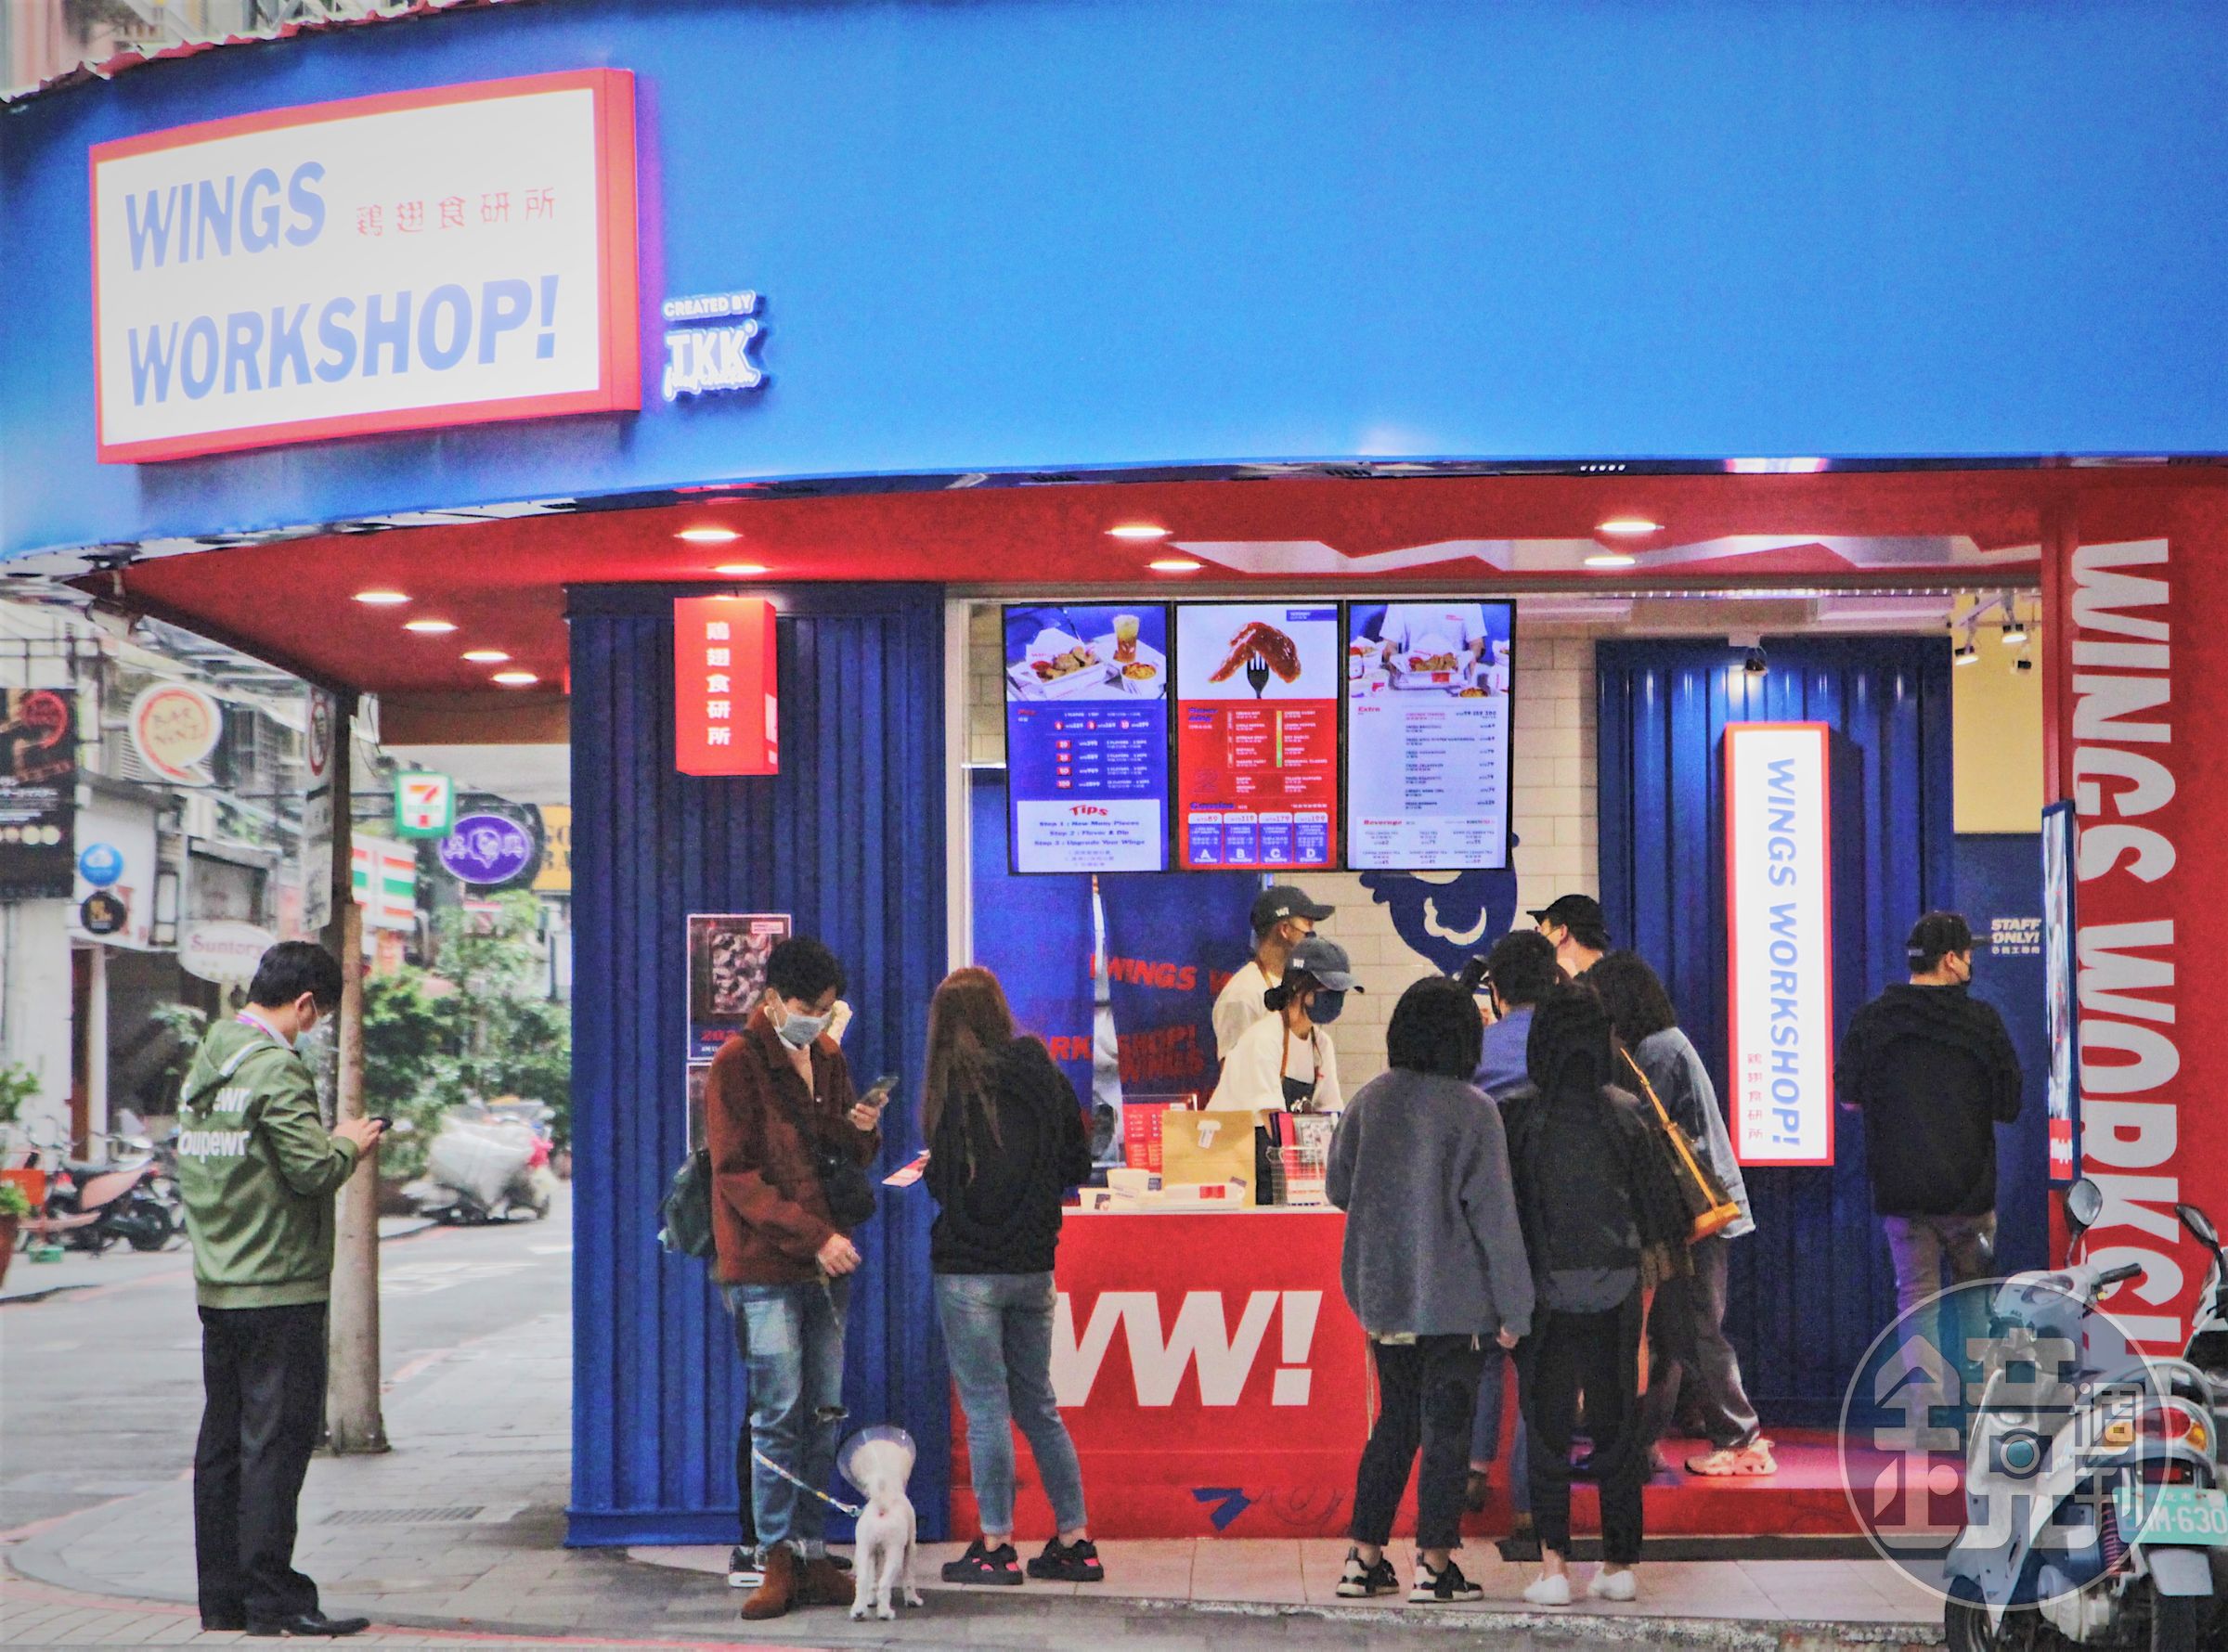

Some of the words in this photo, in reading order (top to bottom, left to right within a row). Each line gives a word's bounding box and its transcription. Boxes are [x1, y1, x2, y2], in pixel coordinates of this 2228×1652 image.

[123, 161, 326, 272] WINGS
[665, 296, 729, 316] CREATED
[732, 293, 753, 311] BY
[127, 274, 561, 407] WORKSHOP!
[666, 329, 746, 375] TKK
[2071, 537, 2176, 883] WINGS
[1069, 805, 1108, 817] Tips
[1767, 757, 1798, 888] WINGS
[1199, 848, 1211, 859] A
[1236, 848, 1245, 858] B
[1270, 848, 1281, 858] C
[1306, 848, 1315, 858] D
[1991, 918, 2041, 931] STAFF
[1991, 931, 2040, 944] ONLY!
[1768, 901, 1801, 1147] WORKSHOP!
